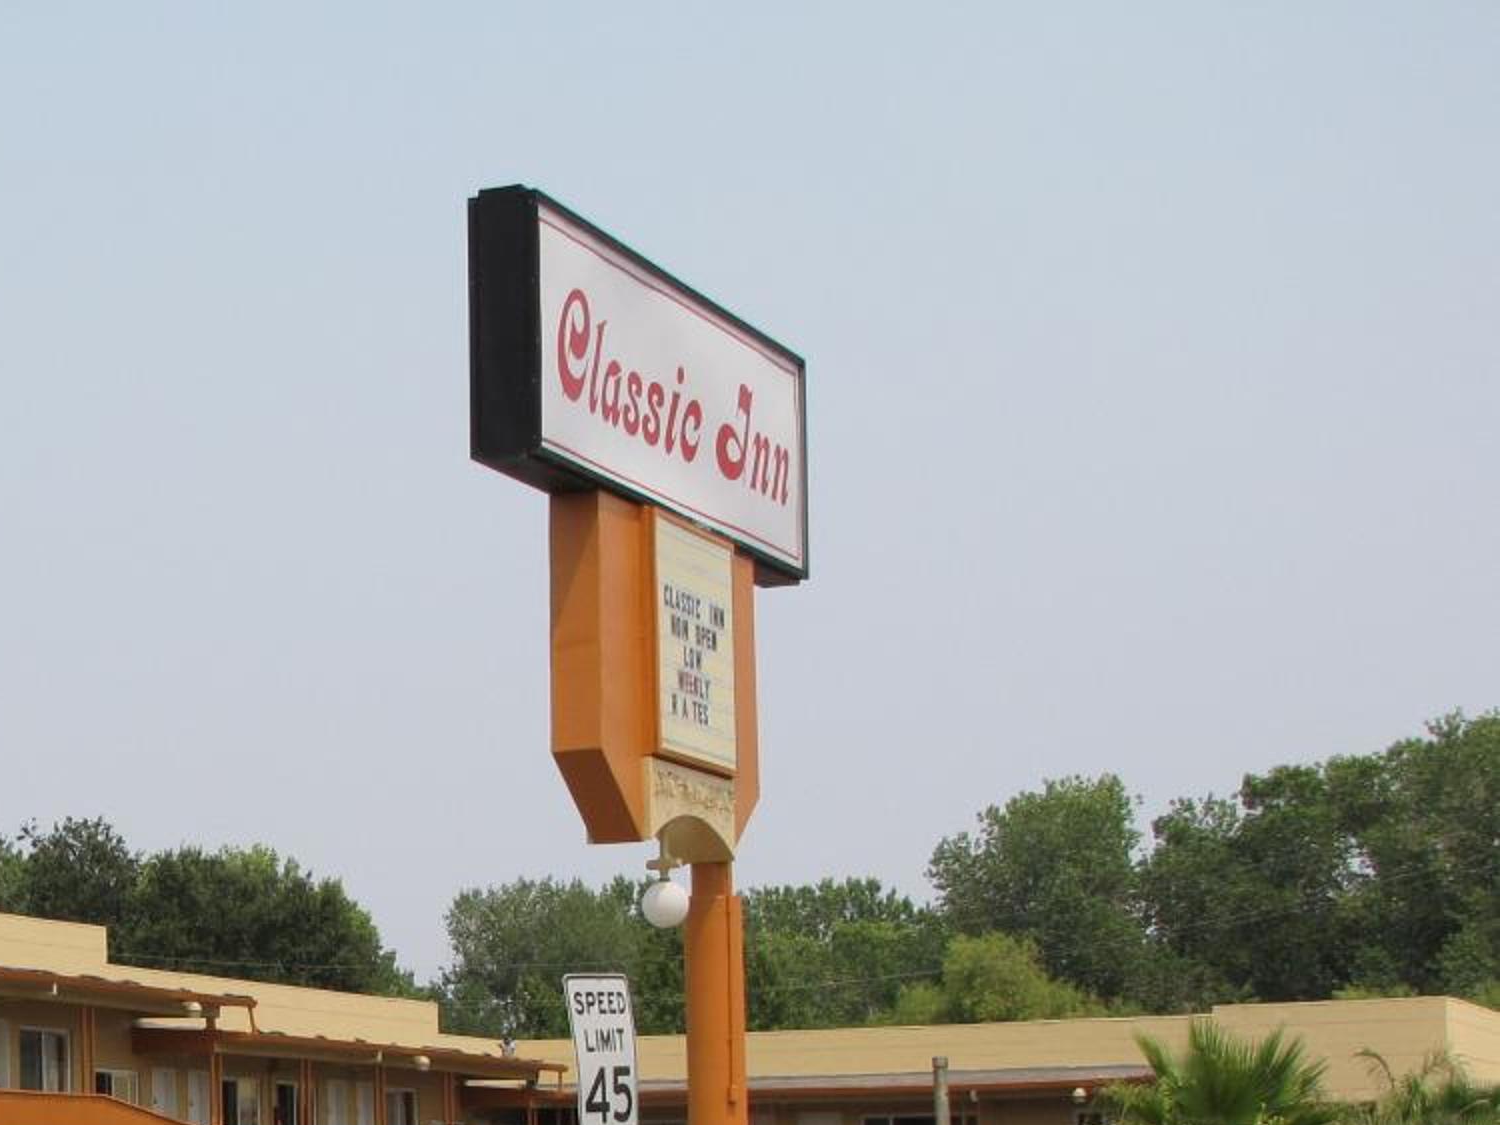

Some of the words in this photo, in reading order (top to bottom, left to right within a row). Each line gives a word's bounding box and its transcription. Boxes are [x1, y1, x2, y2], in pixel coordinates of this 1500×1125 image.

[557, 288, 702, 463] Classic
[716, 383, 789, 506] Inn
[663, 585, 701, 619] CLASSIC
[709, 603, 725, 628] INN
[671, 615, 689, 641] NOW
[696, 624, 717, 651] OPEN
[683, 647, 702, 671] LOW
[678, 670, 711, 699] WEEKLY
[573, 991, 626, 1015] SPEED
[584, 1028, 624, 1052] LIMIT
[586, 1066, 632, 1124] 45
